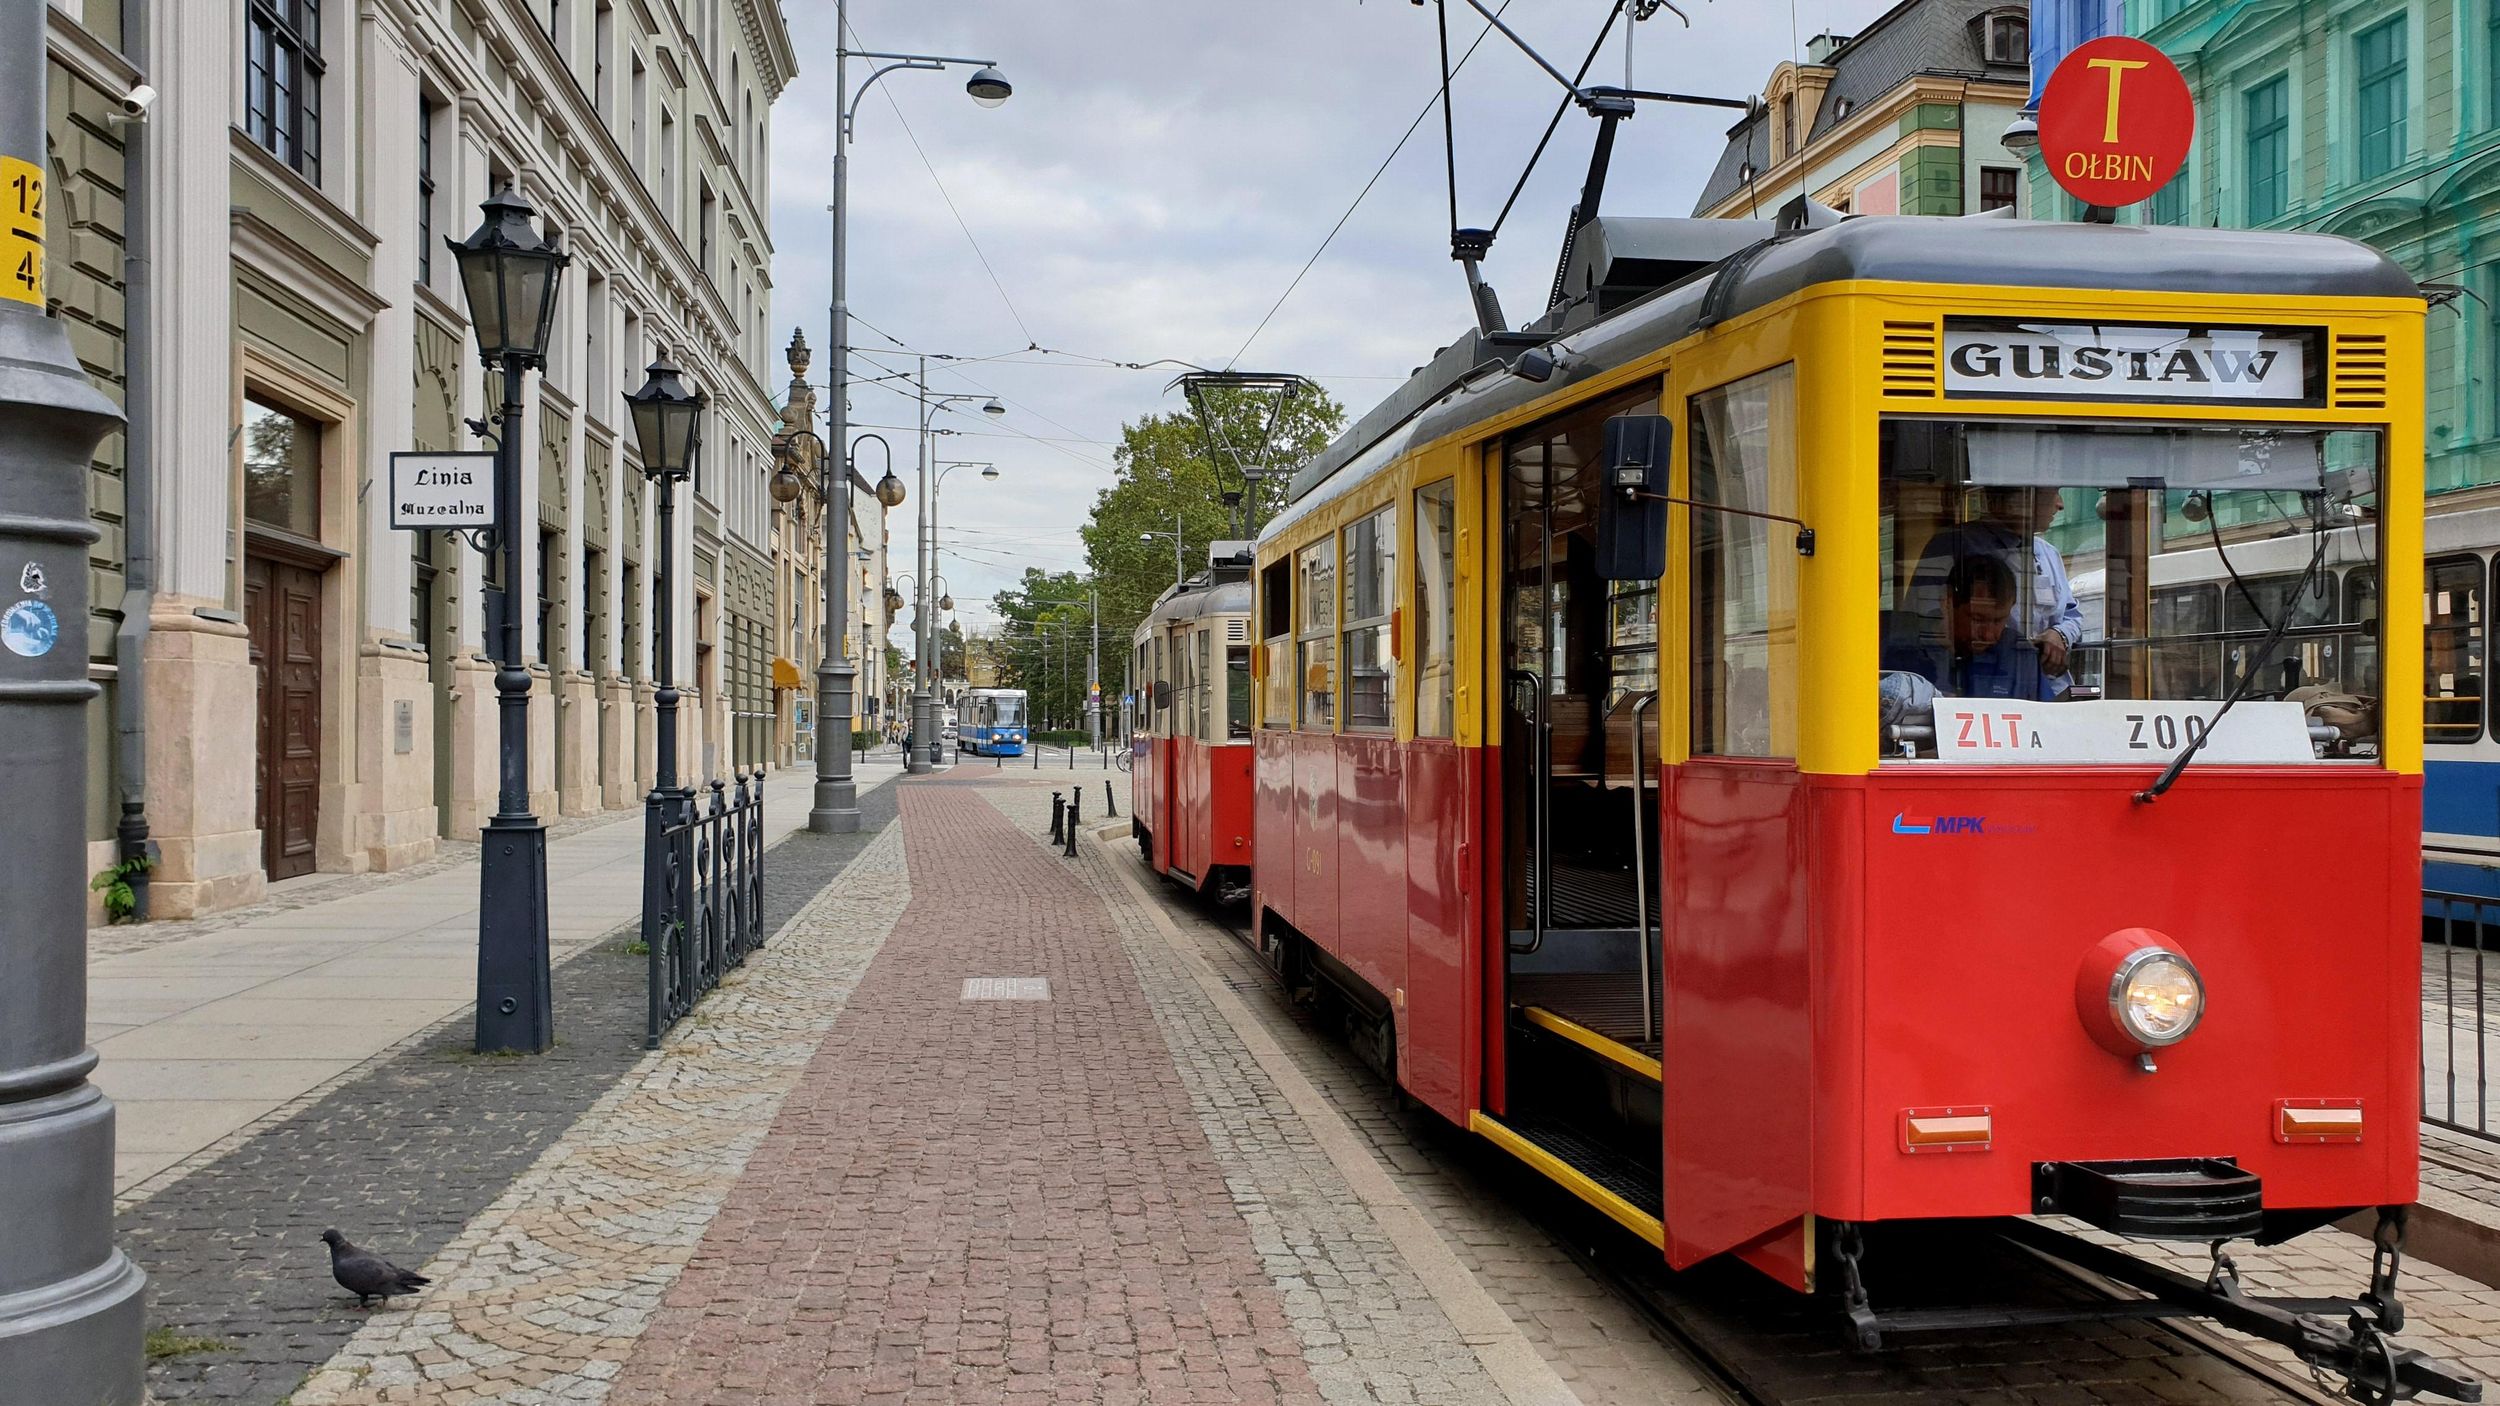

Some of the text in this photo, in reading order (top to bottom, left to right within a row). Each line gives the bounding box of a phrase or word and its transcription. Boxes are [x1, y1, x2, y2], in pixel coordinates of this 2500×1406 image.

[2086, 58, 2150, 143] T
[2064, 152, 2154, 182] OŁBIN
[12, 174, 43, 220] 12
[1949, 342, 2278, 384] GUSTAW
[414, 466, 473, 487] Linia
[400, 500, 485, 516] Muzealna
[2030, 730, 2043, 748] A
[2125, 714, 2208, 750] ZOO
[1934, 816, 1986, 834] MPK
